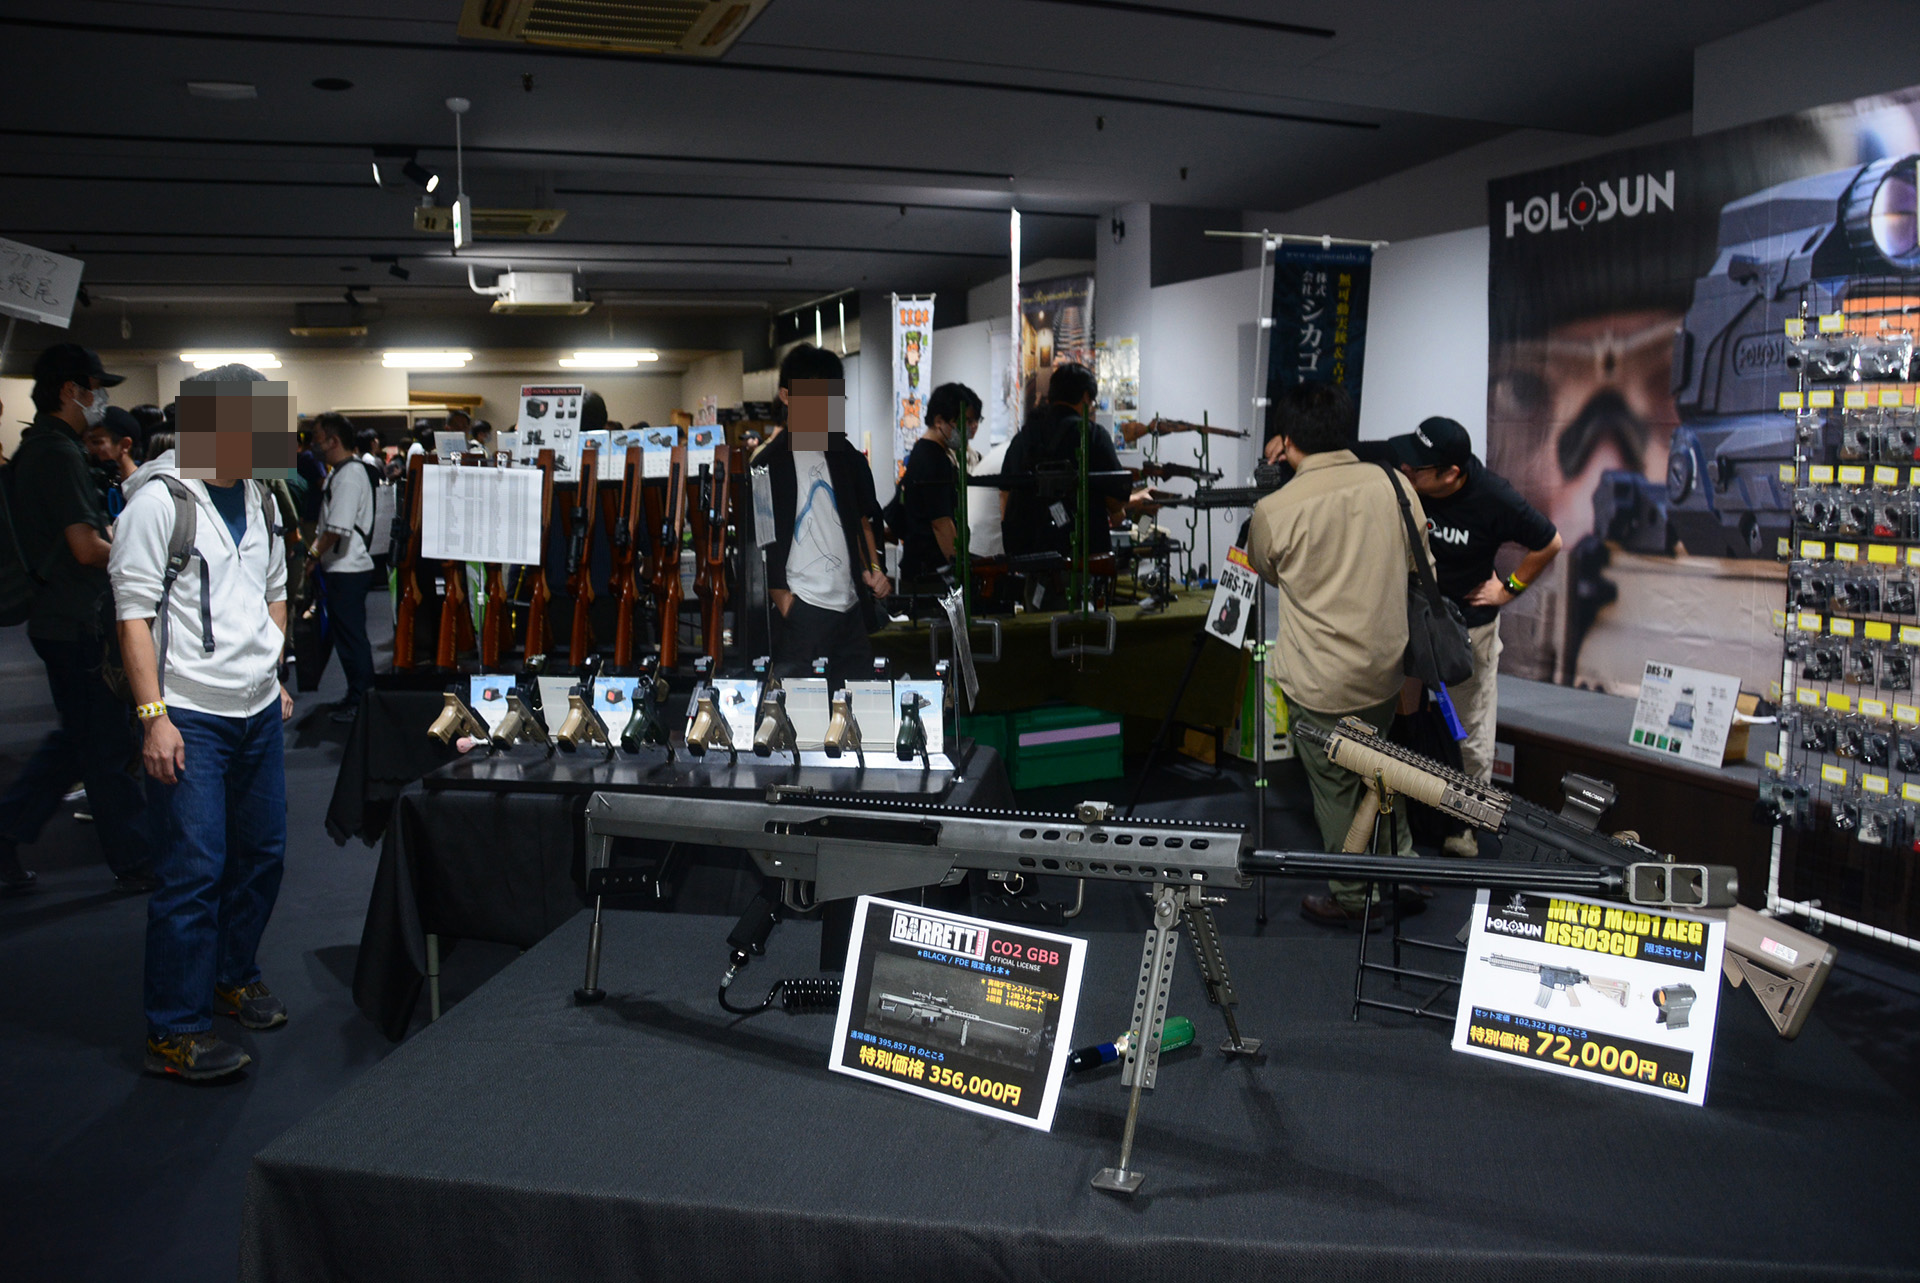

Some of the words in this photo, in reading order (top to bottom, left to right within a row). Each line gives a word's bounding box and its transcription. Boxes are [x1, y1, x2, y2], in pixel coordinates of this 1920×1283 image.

[1506, 170, 1675, 238] HOLOSUN
[0, 271, 59, 306] 後尾
[1298, 298, 1325, 384] シカゴ
[895, 914, 977, 954] BARRETT
[1486, 915, 1543, 939] HOLOSUN
[1547, 897, 1602, 926] MK18
[1604, 907, 1660, 939] MOD1
[1662, 916, 1704, 946] AEG
[991, 939, 1022, 958] CO2
[1027, 947, 1059, 965] GBB
[1544, 920, 1639, 958] HS503CU
[1644, 942, 1704, 963] 限定5セット
[923, 950, 947, 962] BLACK
[954, 957, 970, 967] FDE
[990, 955, 1015, 967] OFFICIAL
[1016, 960, 1041, 972] LICENSE
[985, 994, 1002, 1005] 2回目
[1005, 999, 1043, 1014] 14時スタート
[987, 987, 1003, 996] 1回目
[1006, 991, 1044, 1006] 12時スタート
[1474, 1008, 1511, 1023] セット定価
[1514, 1017, 1547, 1031] 102,322
[1548, 1024, 1556, 1033] 円
[1557, 1025, 1588, 1039] のところ
[850, 1030, 877, 1044] 通常価格
[878, 1037, 907, 1052] 395,857
[908, 1045, 917, 1055] 円
[917, 1046, 945, 1061] のところ
[1470, 1025, 1530, 1053] 特別価格
[1535, 1031, 1658, 1082] 72,000円
[1662, 1070, 1688, 1090] (込)
[859, 1045, 925, 1081] 特別価格
[928, 1065, 1022, 1106] 356,000円
